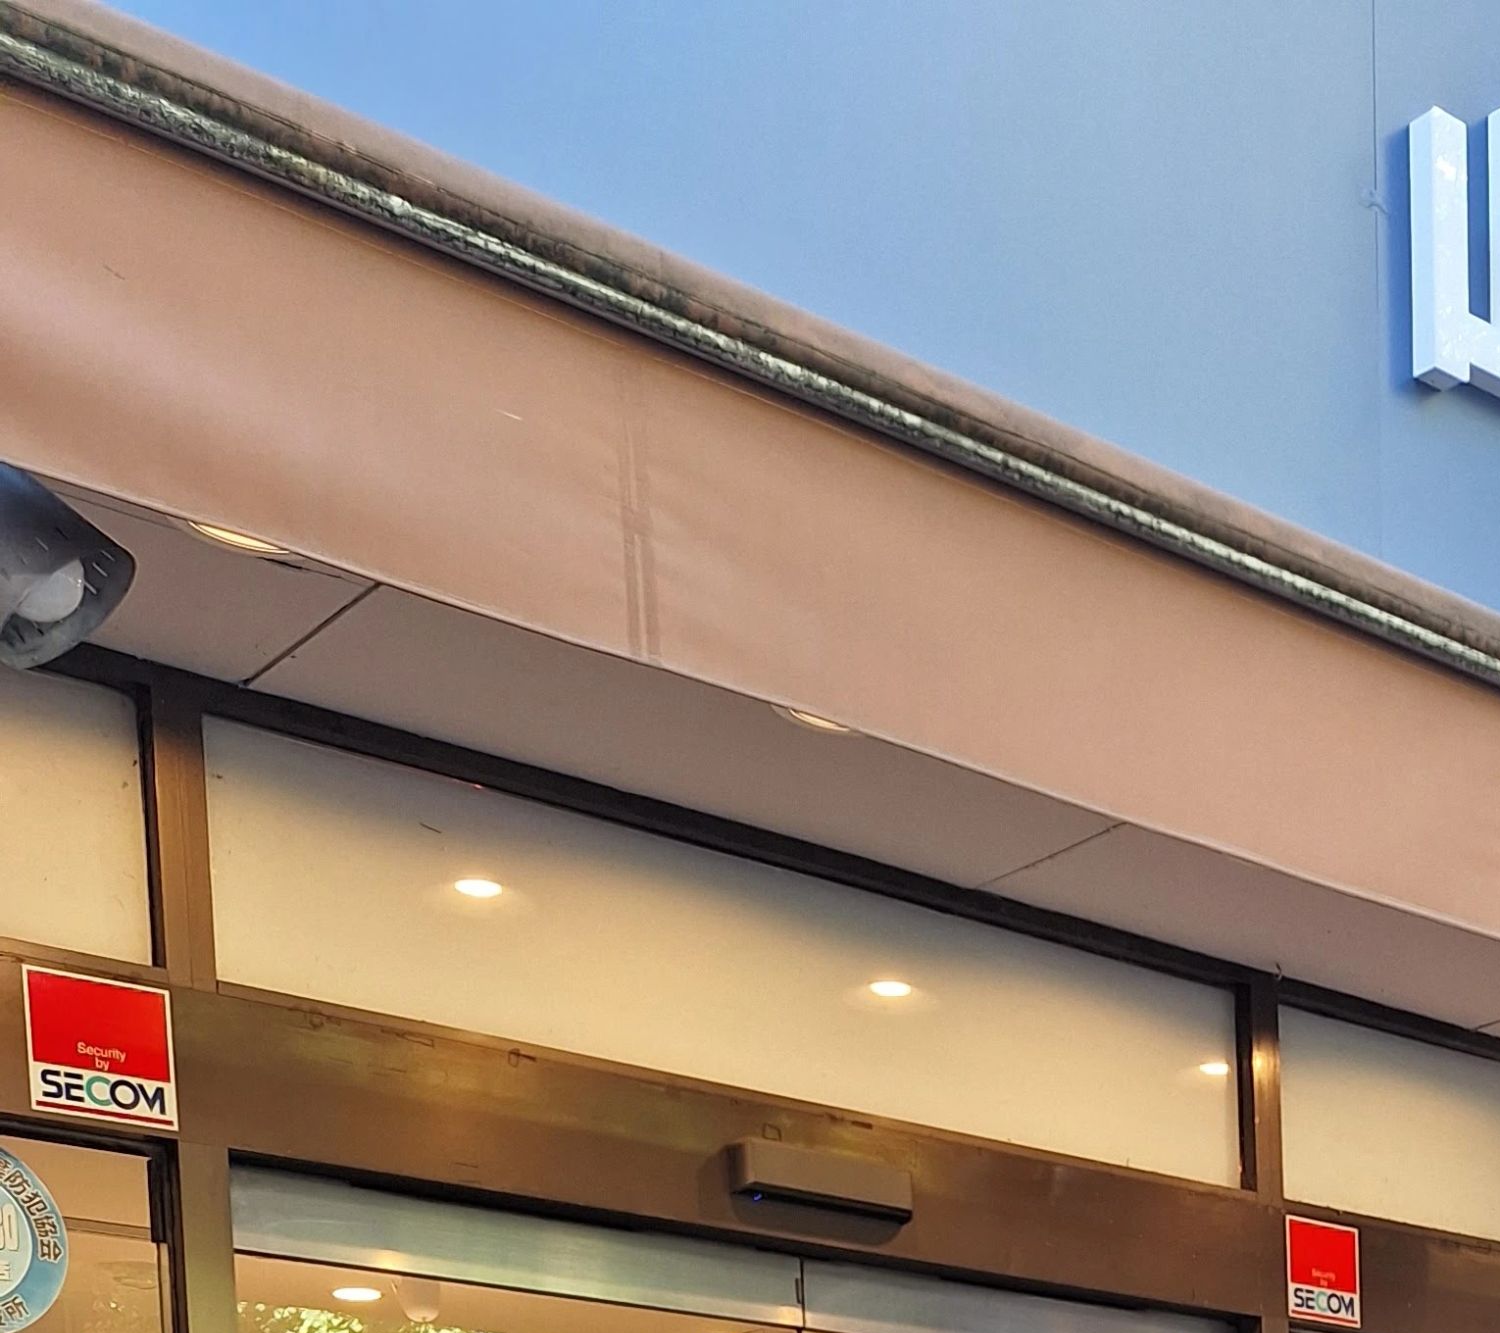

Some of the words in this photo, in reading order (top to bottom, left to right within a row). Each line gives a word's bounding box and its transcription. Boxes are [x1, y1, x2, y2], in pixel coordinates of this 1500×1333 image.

[76, 1041, 127, 1063] Security
[95, 1056, 110, 1071] by
[41, 1069, 166, 1115] SECOM
[1294, 1288, 1355, 1318] SECOM
